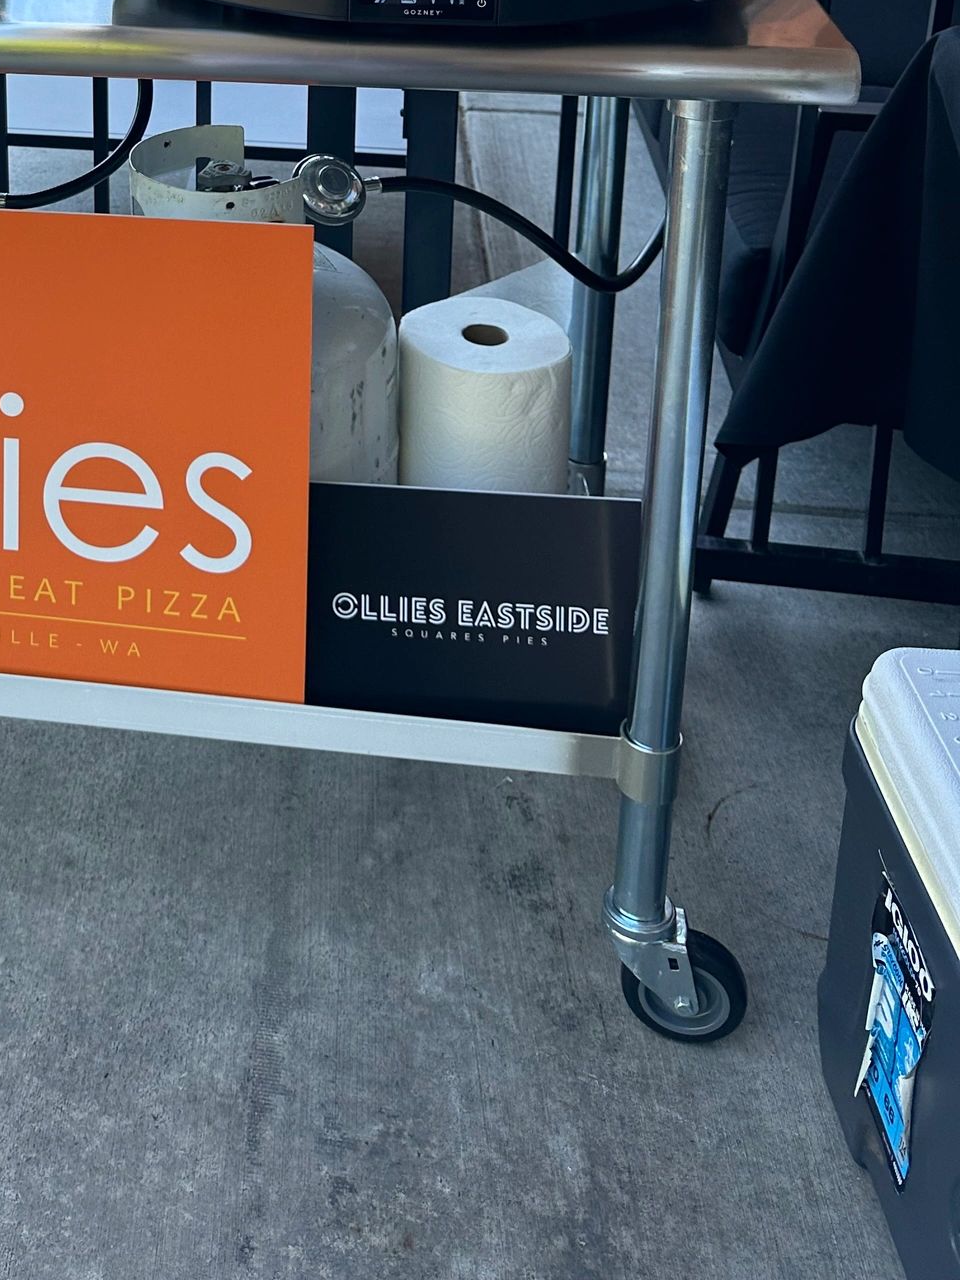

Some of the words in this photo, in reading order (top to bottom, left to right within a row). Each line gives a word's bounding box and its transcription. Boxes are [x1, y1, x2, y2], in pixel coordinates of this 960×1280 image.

[116, 585, 242, 623] PIZZA
[332, 592, 447, 625] OLLIES
[457, 599, 609, 635] EASTSIDE
[99, 638, 141, 657] WA
[391, 627, 485, 643] SQUARES
[502, 634, 548, 646] PIES
[885, 887, 933, 1002] IGLOO
